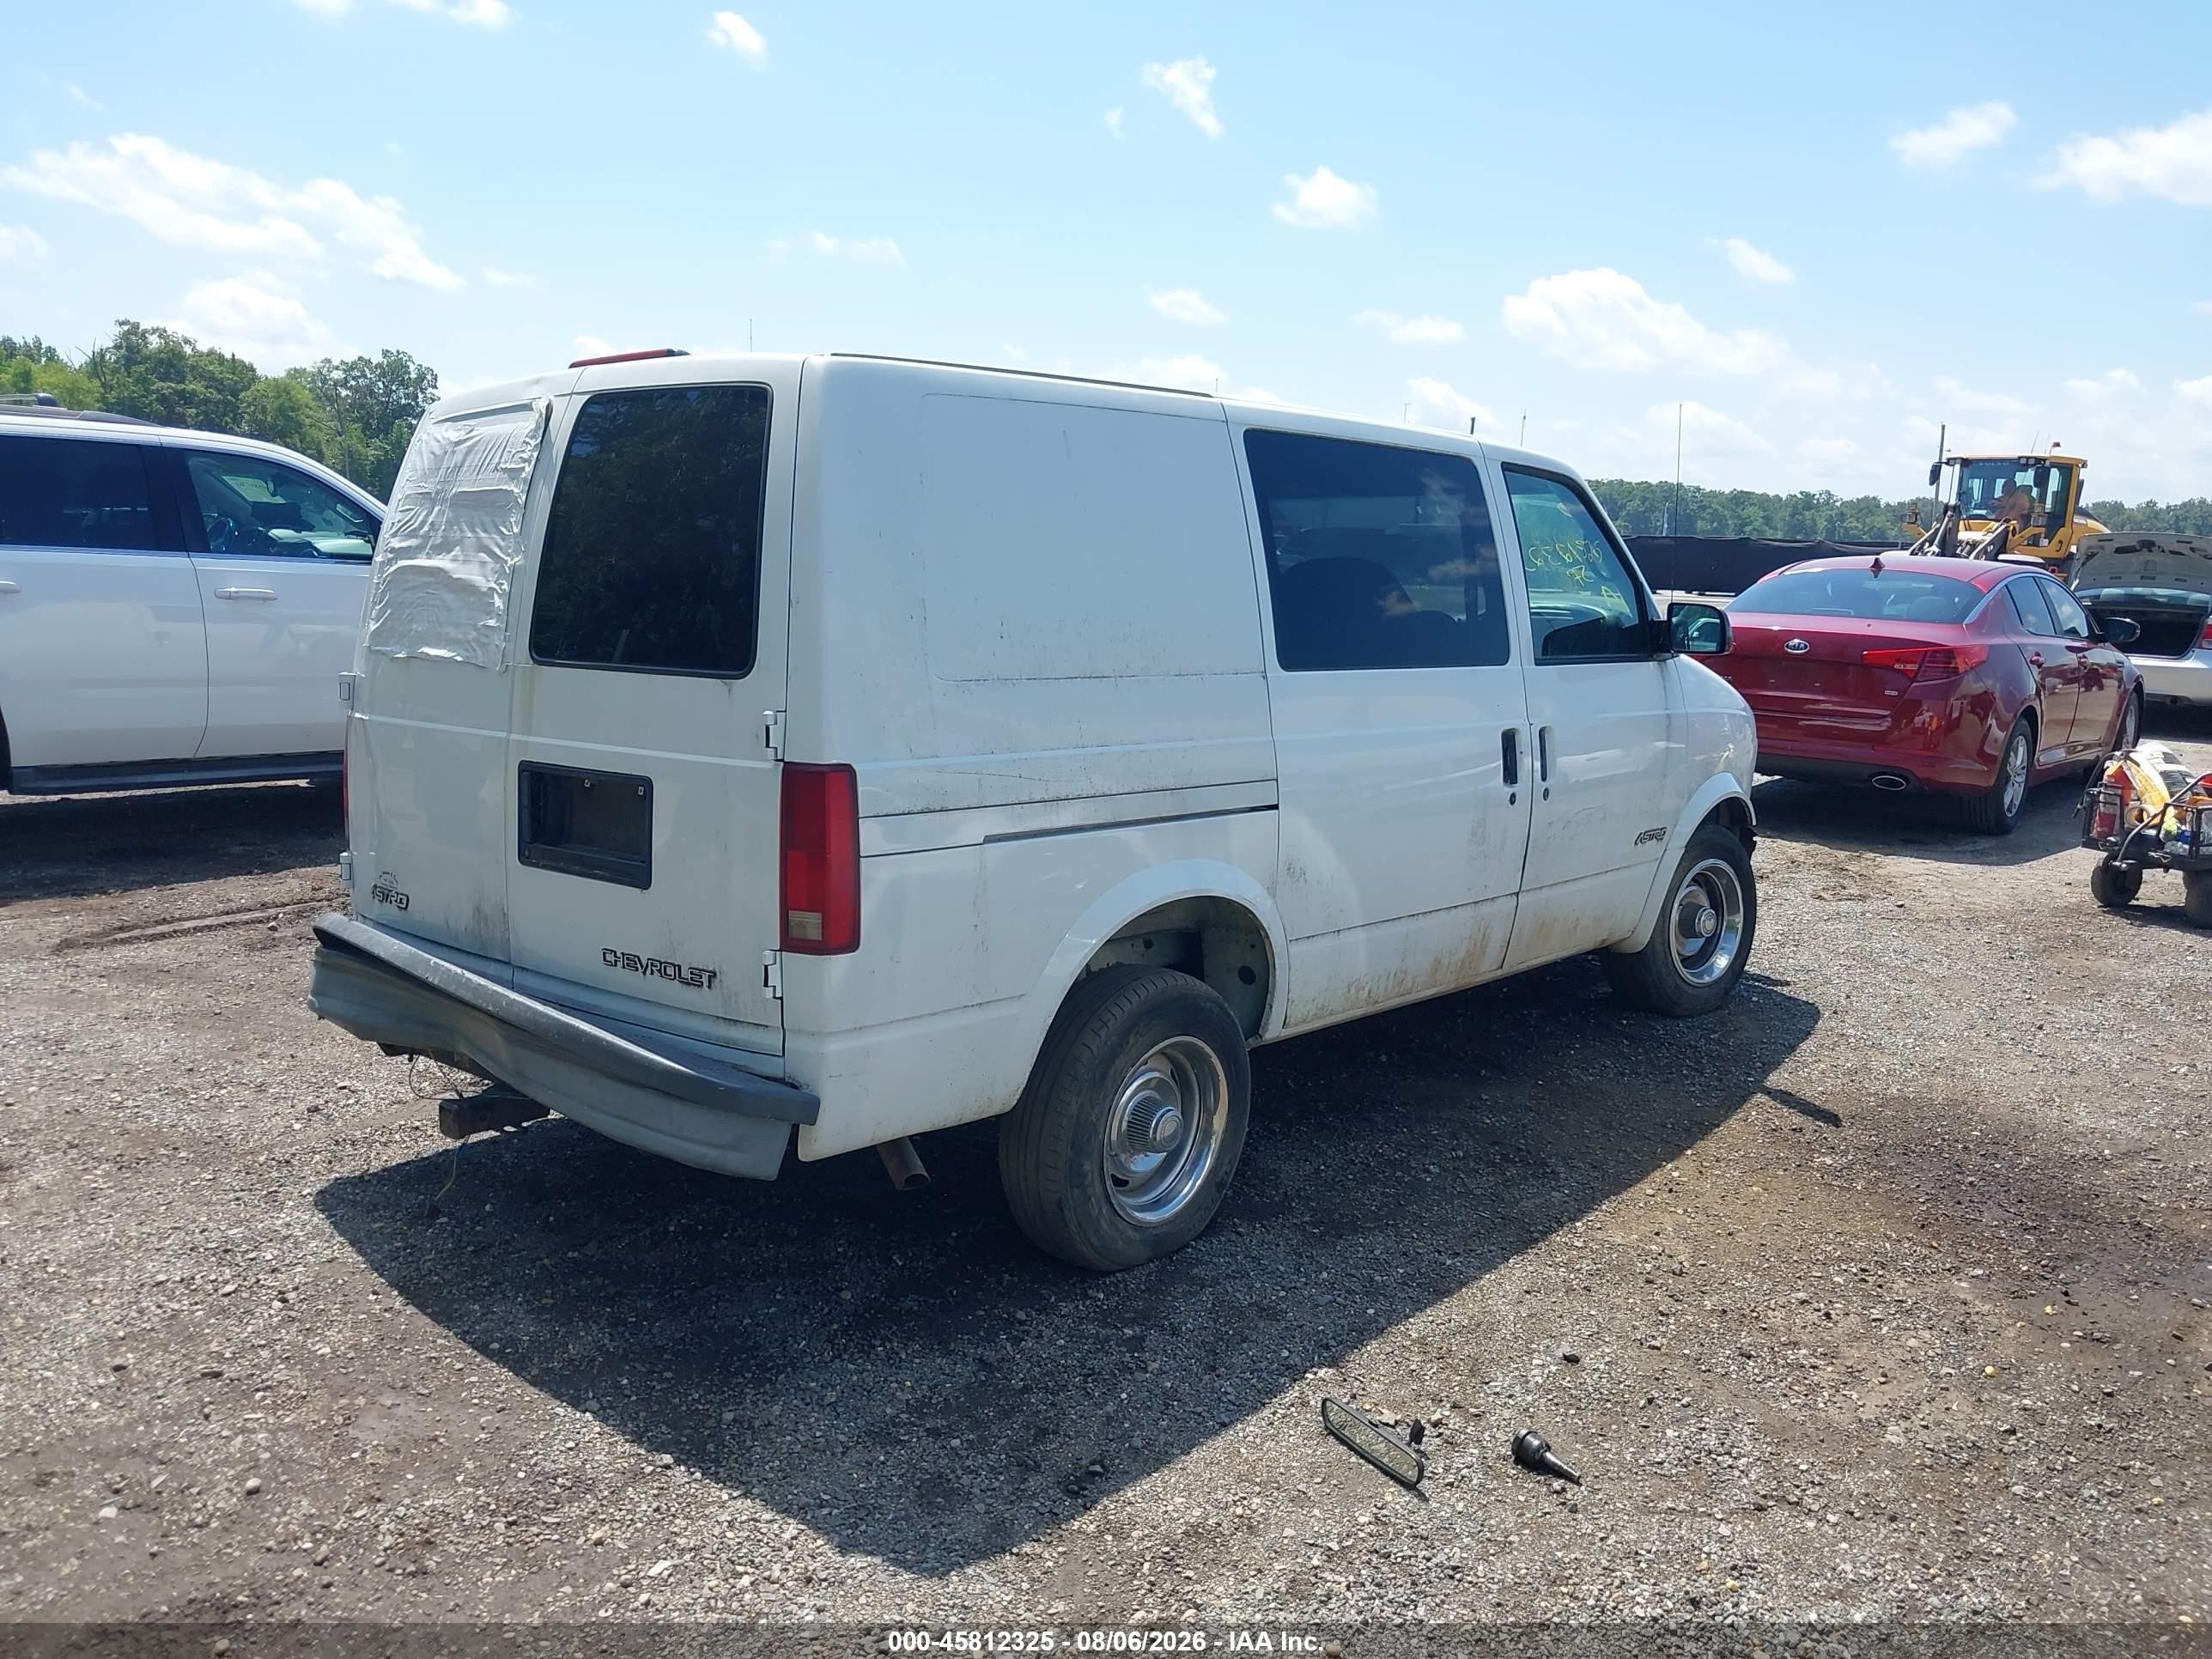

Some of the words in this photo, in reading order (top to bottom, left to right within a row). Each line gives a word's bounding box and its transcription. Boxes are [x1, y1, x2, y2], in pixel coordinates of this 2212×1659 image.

[1634, 826, 1668, 846] ASTRO
[371, 884, 410, 910] ASTRO
[600, 947, 718, 989] CHEVROLET
